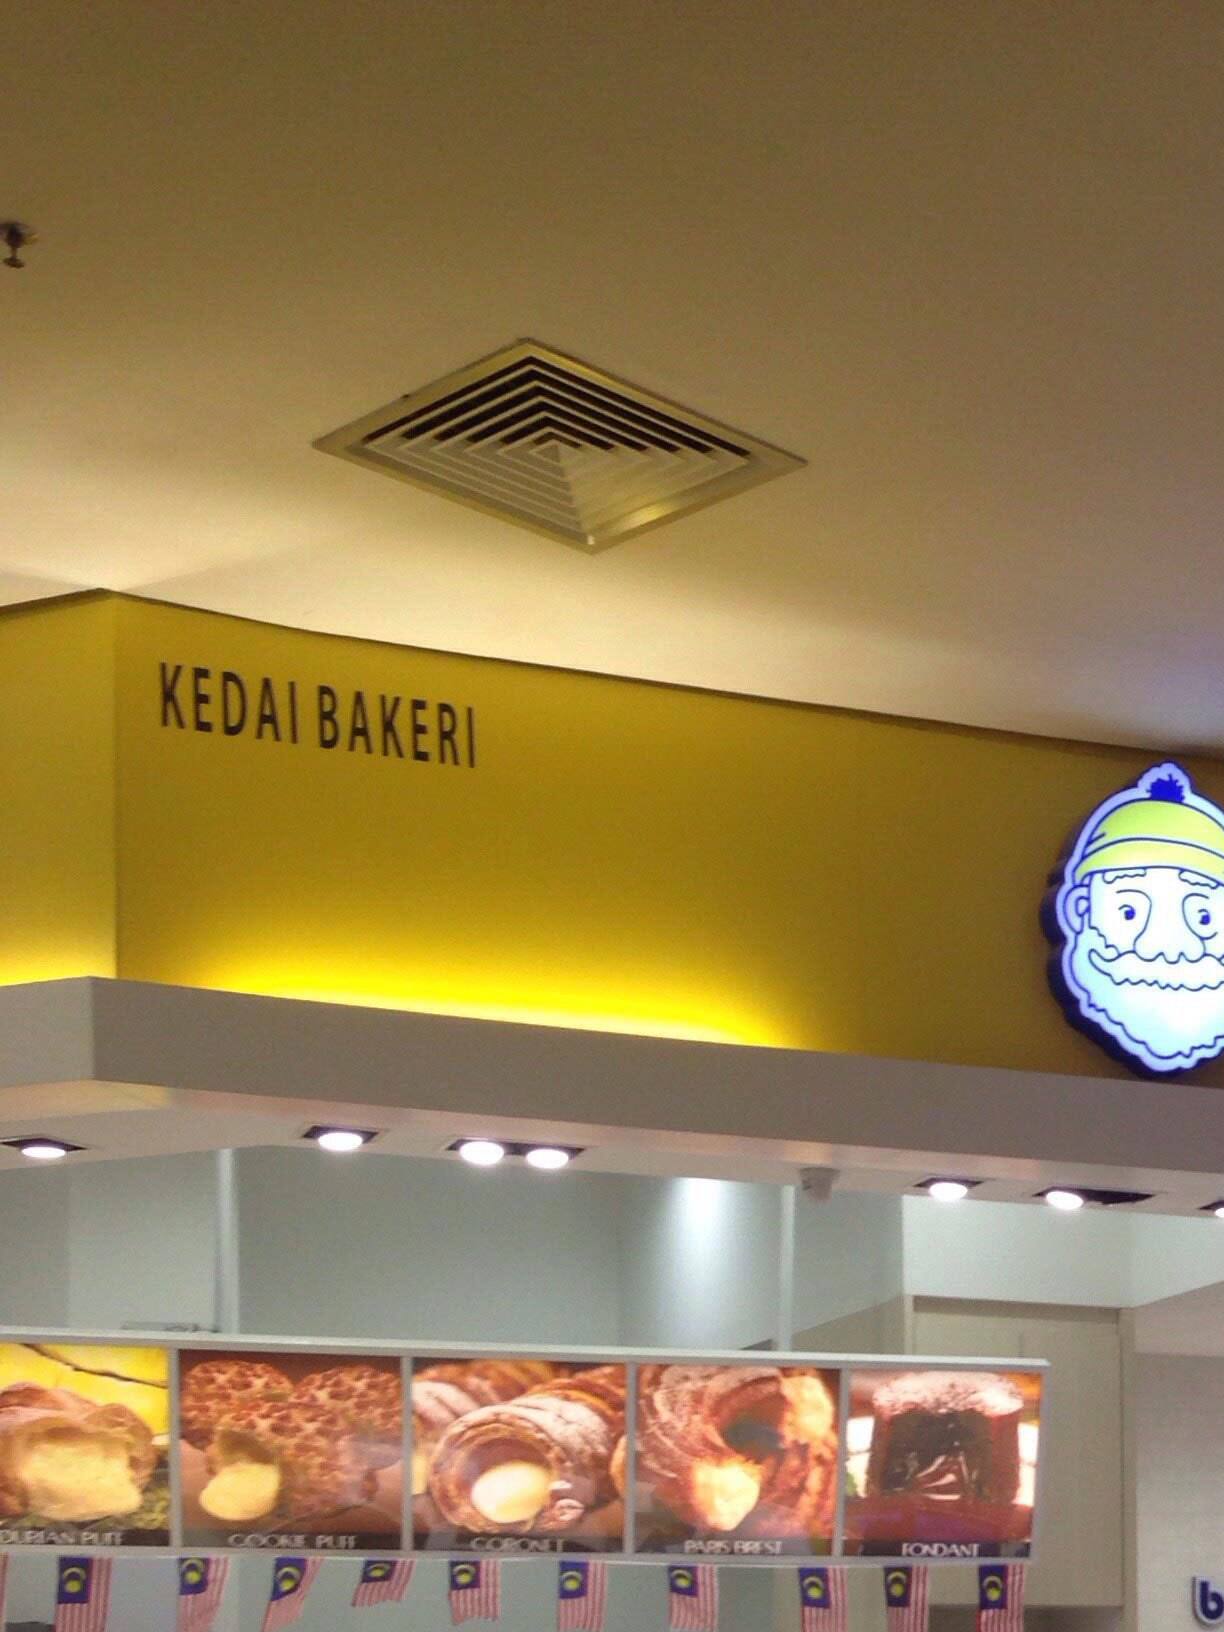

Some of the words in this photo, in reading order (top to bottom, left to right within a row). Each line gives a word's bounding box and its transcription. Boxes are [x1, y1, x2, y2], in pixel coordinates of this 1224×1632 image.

[159, 662, 299, 744] KEDAI
[318, 685, 476, 768] BAKERI
[902, 1542, 980, 1557] FONDANT
